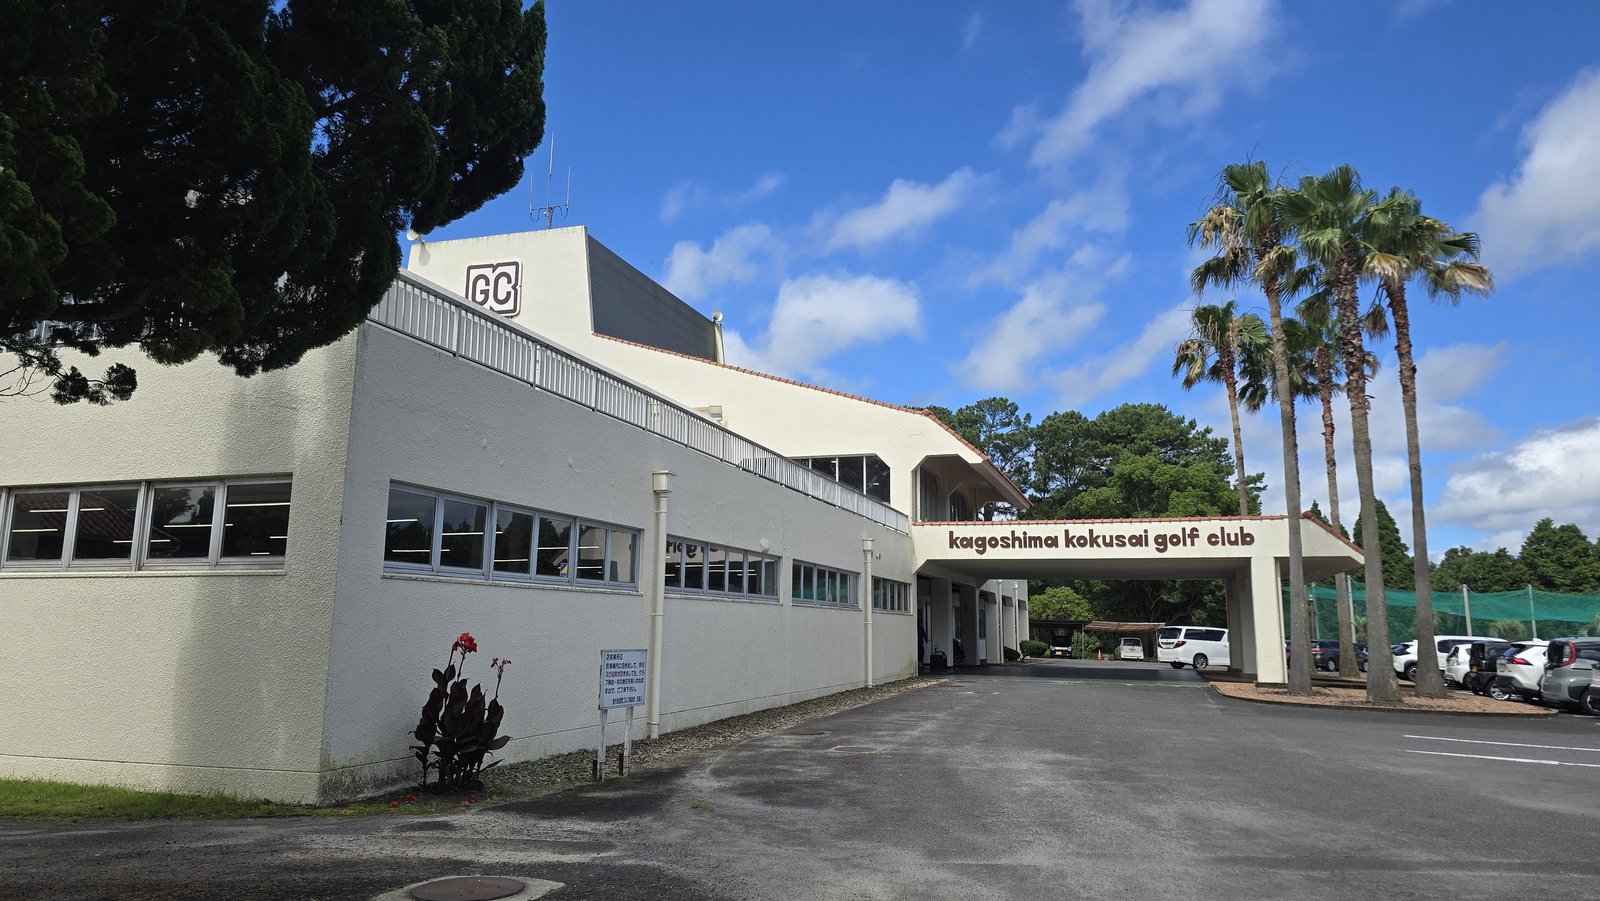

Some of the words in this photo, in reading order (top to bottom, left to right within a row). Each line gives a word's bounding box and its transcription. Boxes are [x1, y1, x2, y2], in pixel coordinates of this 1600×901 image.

[471, 271, 513, 307] GC
[949, 530, 1059, 555] kagoshima
[1064, 529, 1149, 548] kokusai
[1154, 527, 1200, 553] golf
[1206, 526, 1255, 547] club
